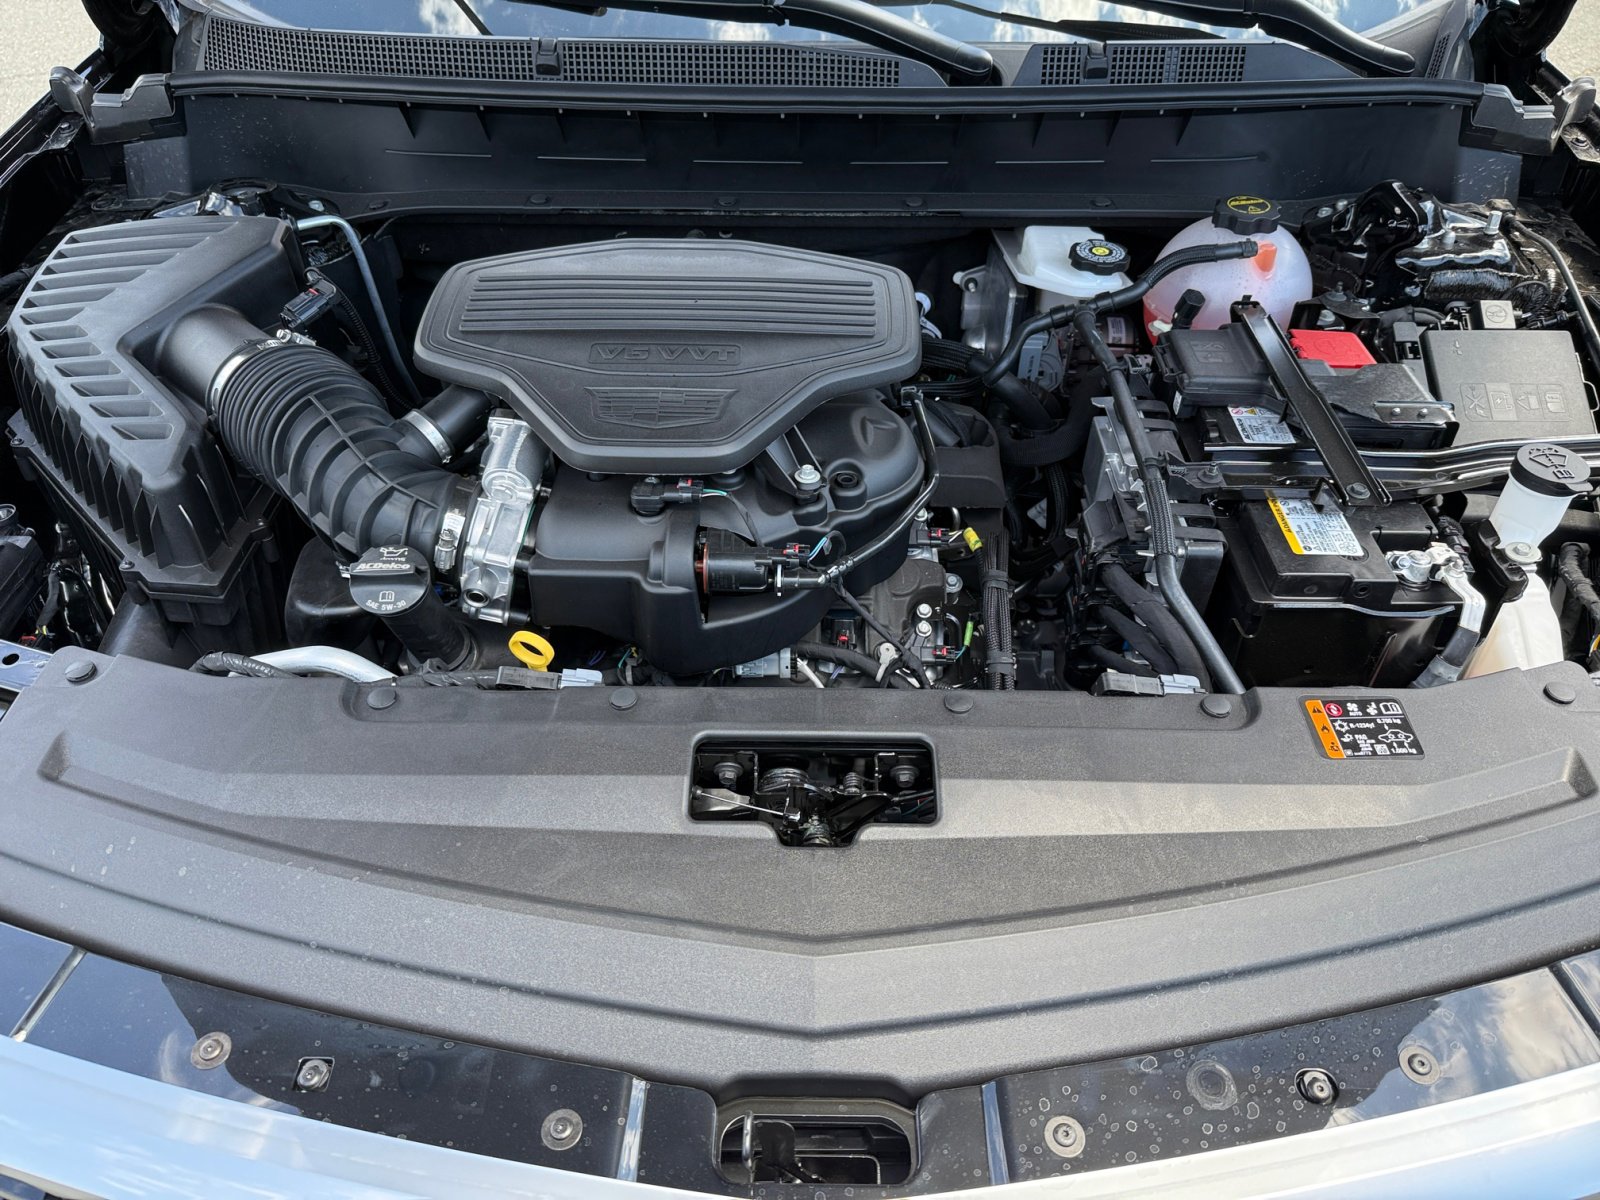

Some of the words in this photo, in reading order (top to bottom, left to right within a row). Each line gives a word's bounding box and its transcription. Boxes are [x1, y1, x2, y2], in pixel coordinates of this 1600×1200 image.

[597, 346, 649, 360] V6
[657, 346, 736, 361] VVT
[356, 562, 410, 570] ACDelco
[365, 600, 380, 610] SAE
[381, 600, 407, 611] 5W-30
